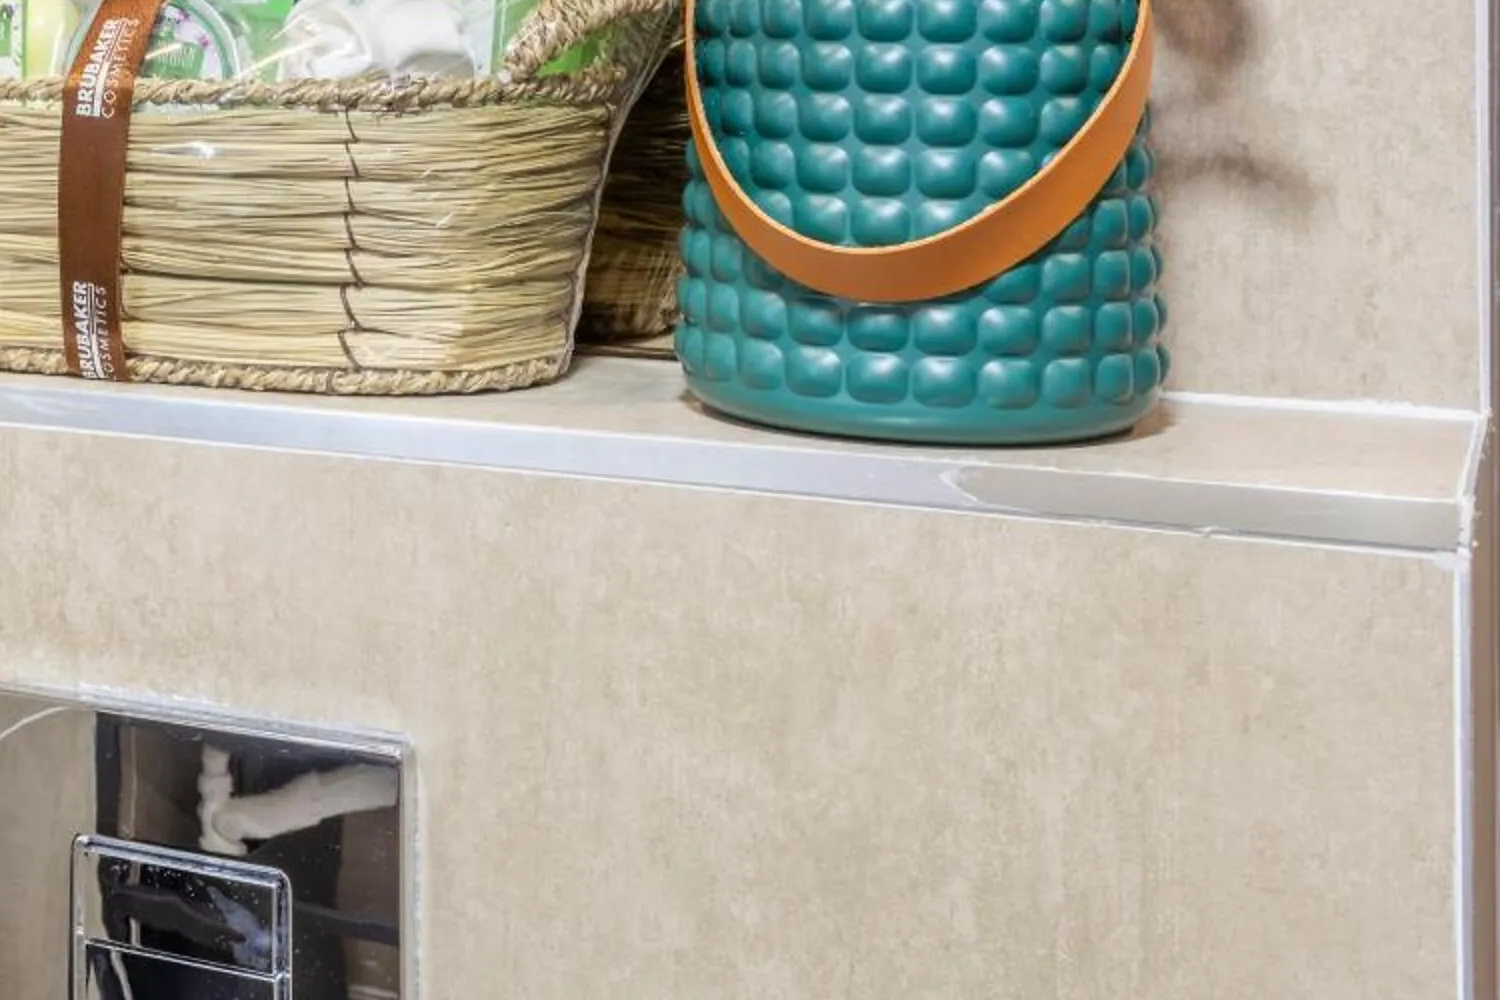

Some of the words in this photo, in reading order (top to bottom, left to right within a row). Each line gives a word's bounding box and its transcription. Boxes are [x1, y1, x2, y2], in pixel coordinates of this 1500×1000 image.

[76, 19, 119, 117] BRUBAKER
[101, 16, 141, 119] COSMETICS
[96, 285, 117, 381] OSMETICS
